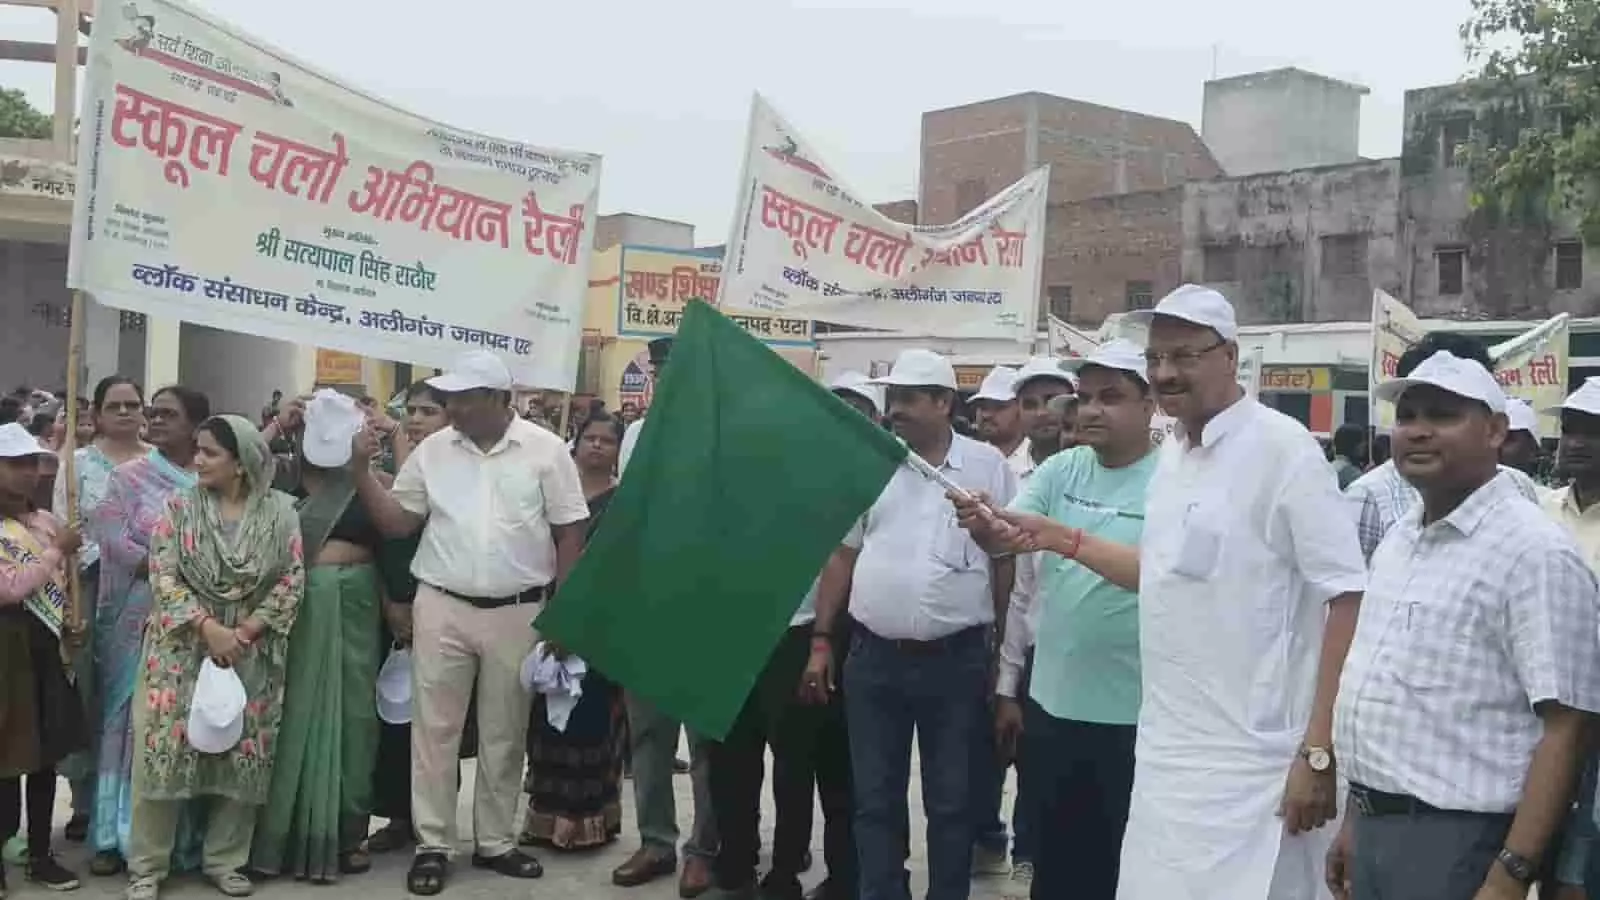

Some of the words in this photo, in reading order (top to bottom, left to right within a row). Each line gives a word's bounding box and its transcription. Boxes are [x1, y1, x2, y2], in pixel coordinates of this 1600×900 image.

[32, 178, 65, 196] नगर
[112, 83, 245, 188] स्कूल
[249, 132, 350, 204] चलो
[348, 160, 512, 249] अभियान
[522, 190, 585, 265] रैली
[762, 184, 844, 260] स्कूल
[256, 227, 280, 258] श्री
[283, 239, 356, 274] सत्यपाल
[359, 250, 392, 283] सिंह
[784, 265, 819, 291] ब्लॉक
[132, 263, 200, 292] ब्लॉक
[203, 276, 290, 311] संसाधन
[360, 309, 445, 339] अलीगंज
[450, 324, 512, 350] जनपद
[625, 271, 668, 300] खण्ड
